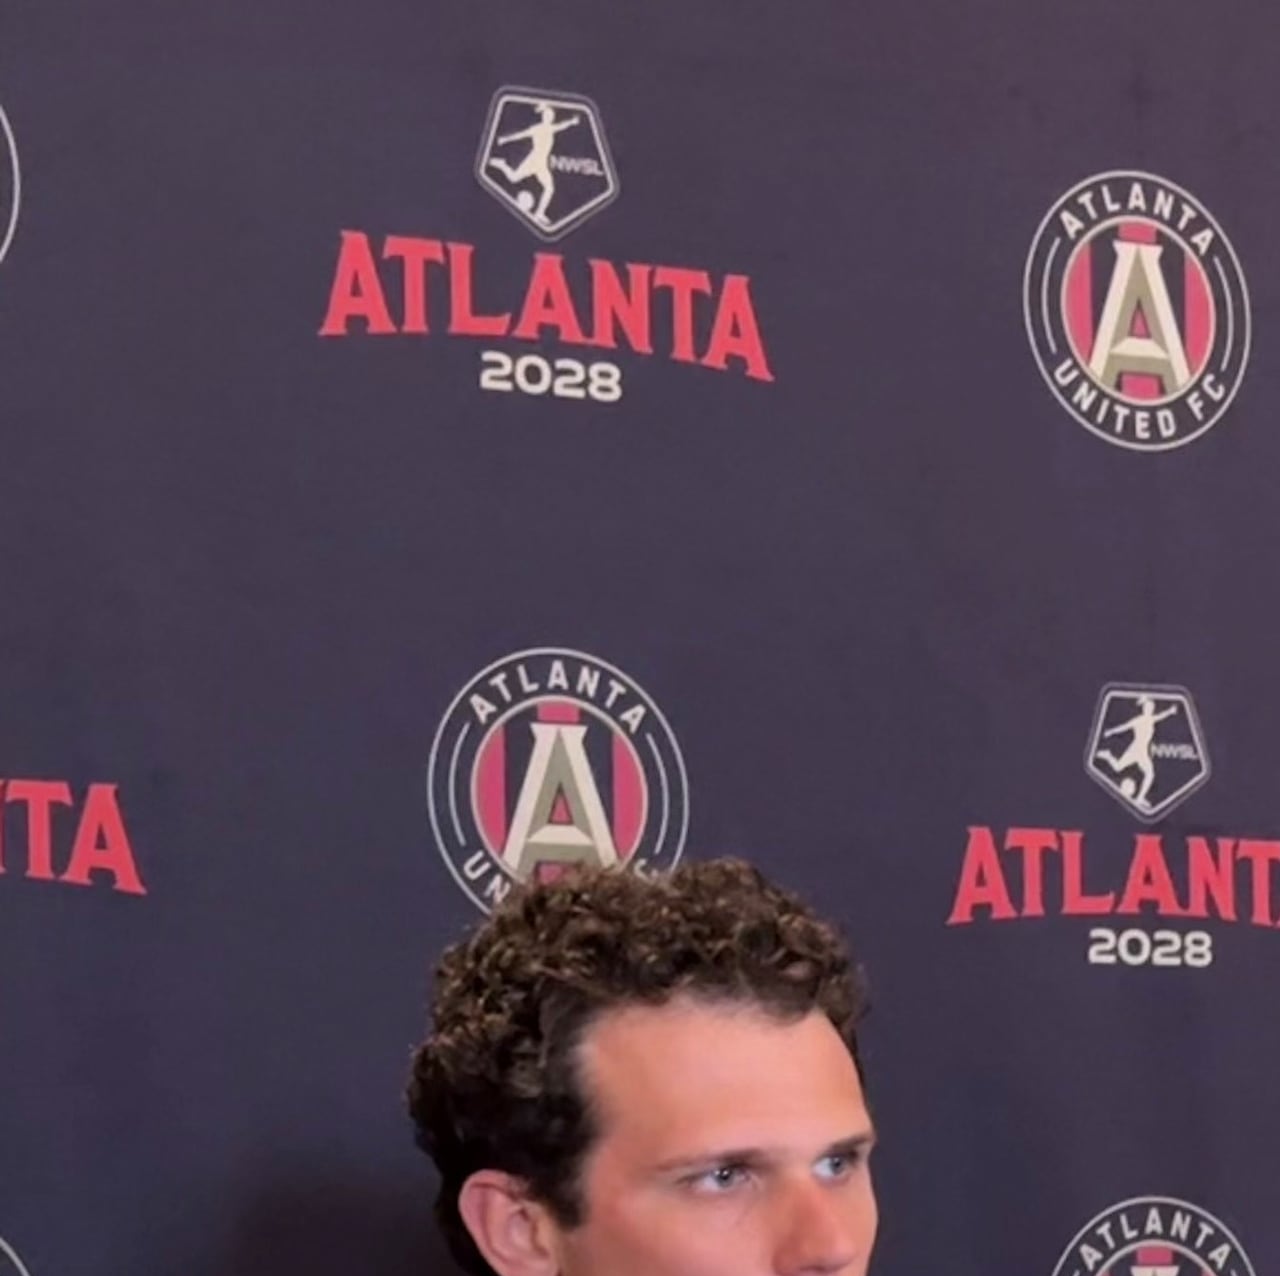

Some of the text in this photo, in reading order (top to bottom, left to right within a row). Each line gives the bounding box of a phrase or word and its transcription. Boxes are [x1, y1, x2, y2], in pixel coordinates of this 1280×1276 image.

[549, 155, 604, 177] NWSL
[1059, 183, 1215, 256] ATLANTA
[317, 229, 775, 382] ATLANTA
[479, 350, 622, 402] 2028
[1054, 358, 1225, 439] UNITED FC
[468, 660, 646, 735] ATLANTA
[1150, 743, 1198, 760] NWSL
[1088, 928, 1212, 968] 2028
[1079, 1207, 1231, 1272] ATLANTA
